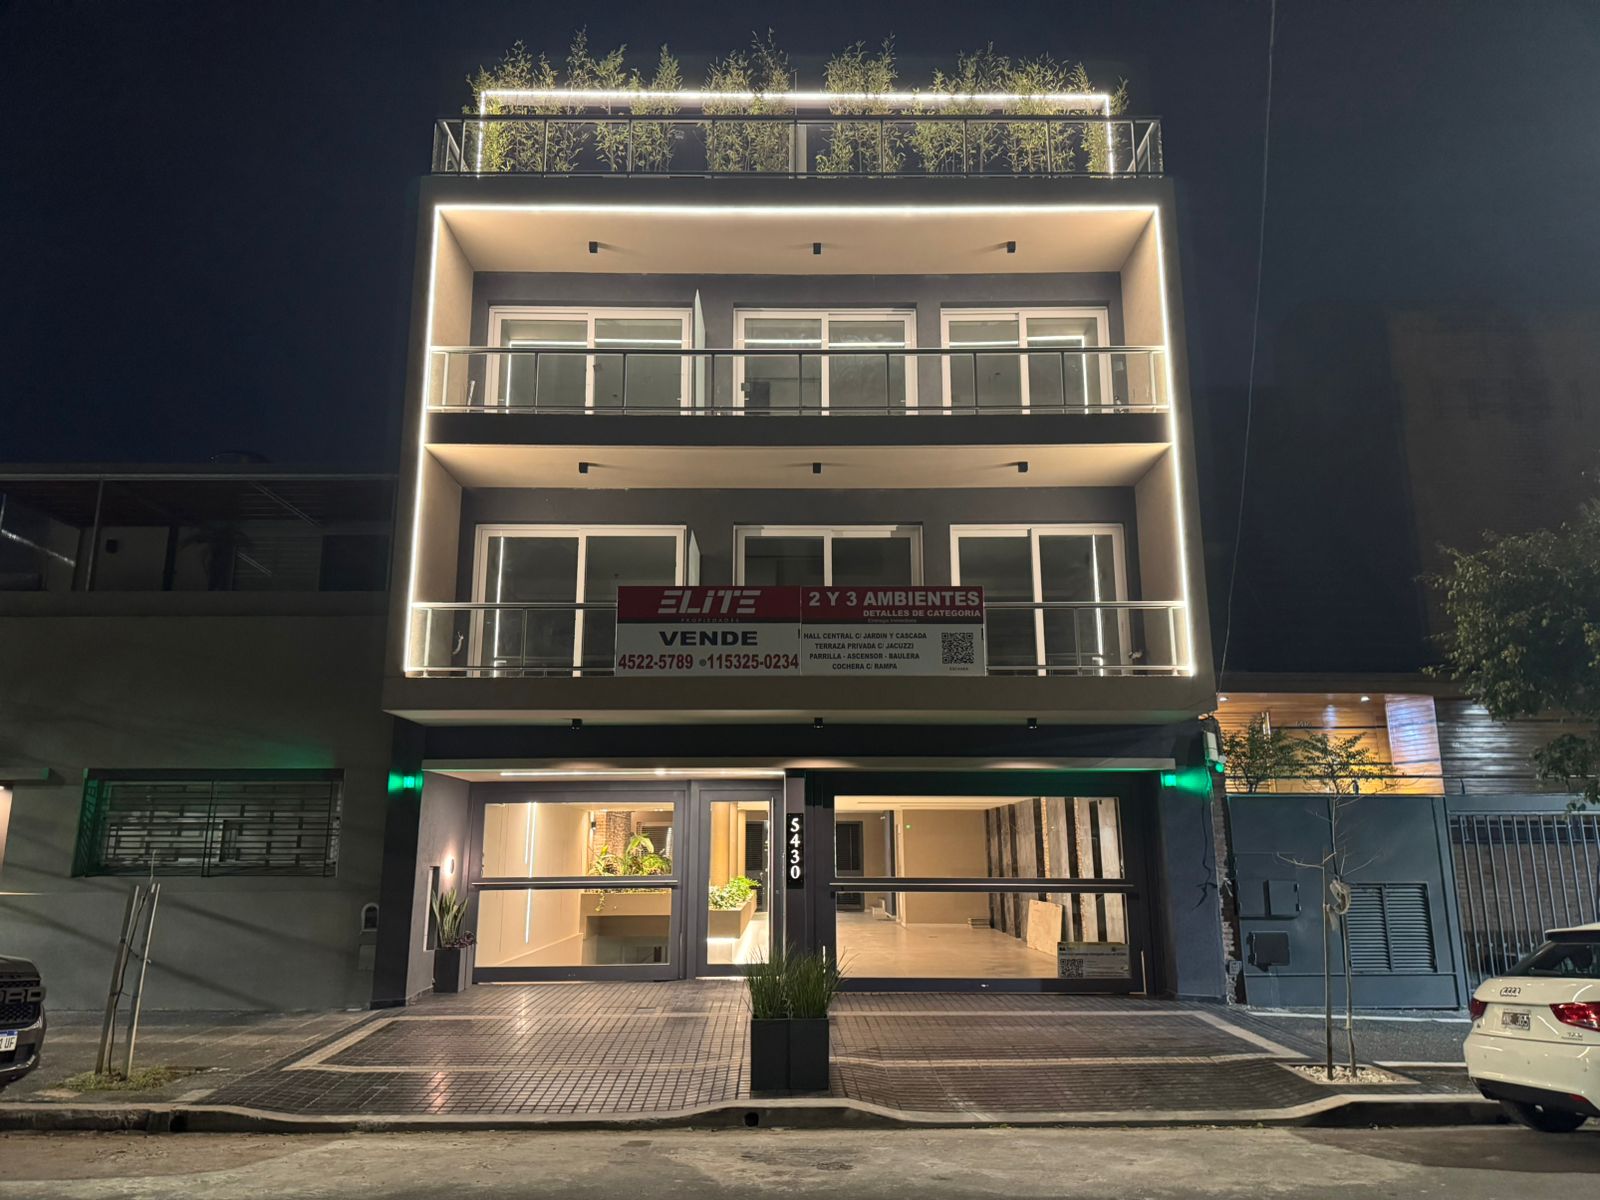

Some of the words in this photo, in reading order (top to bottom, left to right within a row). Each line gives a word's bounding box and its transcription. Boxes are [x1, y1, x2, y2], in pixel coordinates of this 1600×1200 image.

[809, 591, 820, 606] 2
[827, 591, 841, 606] Y
[846, 591, 857, 606] 3
[863, 591, 980, 606] AMBIENTES
[659, 631, 758, 646] VENDE
[618, 654, 694, 670] 4522-5789
[706, 653, 799, 669] 115325-0234
[790, 817, 801, 879] 5430
[0, 986, 46, 1005] RD
